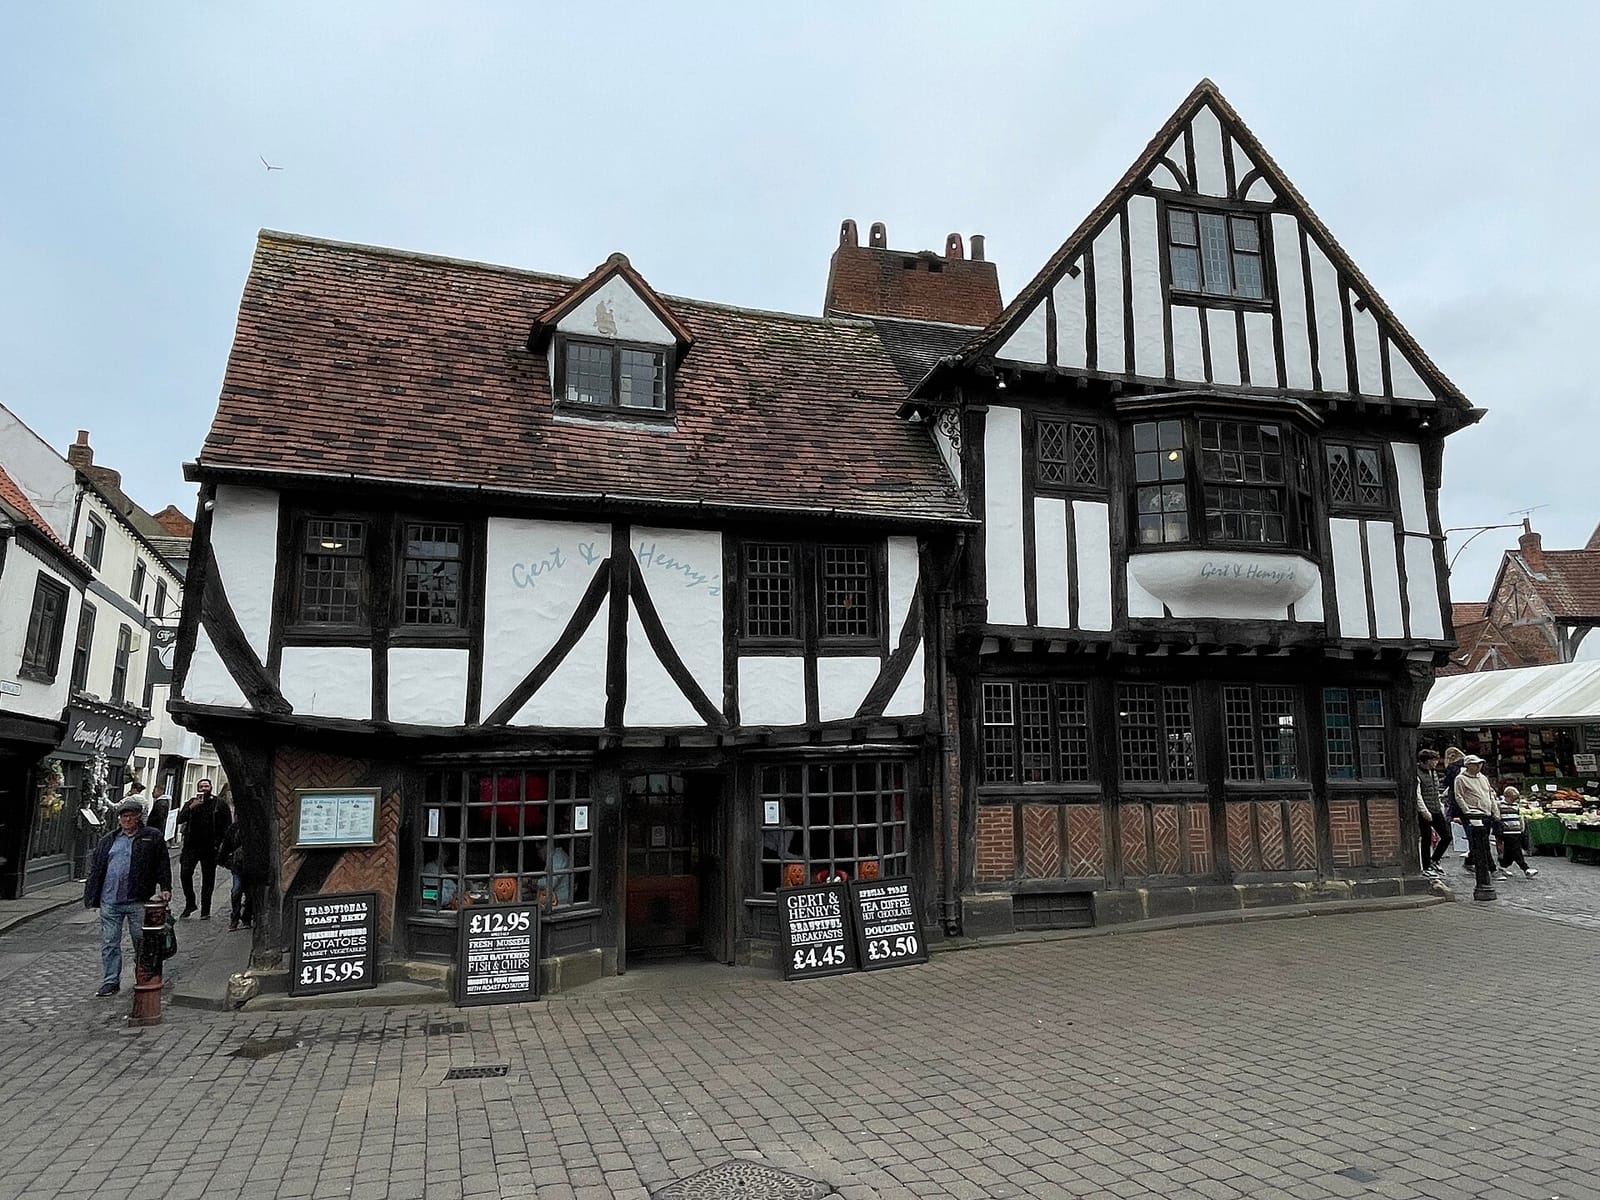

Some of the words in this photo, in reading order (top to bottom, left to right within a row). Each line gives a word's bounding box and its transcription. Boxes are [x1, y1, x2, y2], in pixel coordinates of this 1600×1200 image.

[512, 547, 567, 588] Gert
[578, 543, 601, 566] &
[638, 542, 720, 597] Henry's
[1201, 562, 1229, 579] Gert
[1246, 563, 1295, 584] Henry's
[787, 892, 826, 909] GERT
[828, 891, 840, 905] &
[860, 901, 879, 913] TEA
[880, 897, 911, 910] COFFEE
[304, 902, 368, 916] TRADITIONAL
[788, 904, 841, 920] HENRY'S
[862, 911, 875, 920] HOT
[877, 907, 912, 919] CHOCOLATE
[304, 915, 339, 926] ROAST
[469, 911, 530, 934] £12.95
[790, 918, 843, 933] BEAUTIFUL
[791, 928, 844, 943] BREAKFASTS
[864, 921, 915, 936] DOUGHNUT
[303, 936, 367, 950] POTATOES
[469, 940, 493, 949] FRESH
[496, 937, 530, 947] MUSSELS
[868, 935, 918, 960] £3.50
[793, 944, 846, 970] £4.45
[300, 960, 364, 985] £15.95
[468, 961, 491, 973] FISH
[492, 960, 500, 971] &
[501, 958, 530, 970] CHIPS
